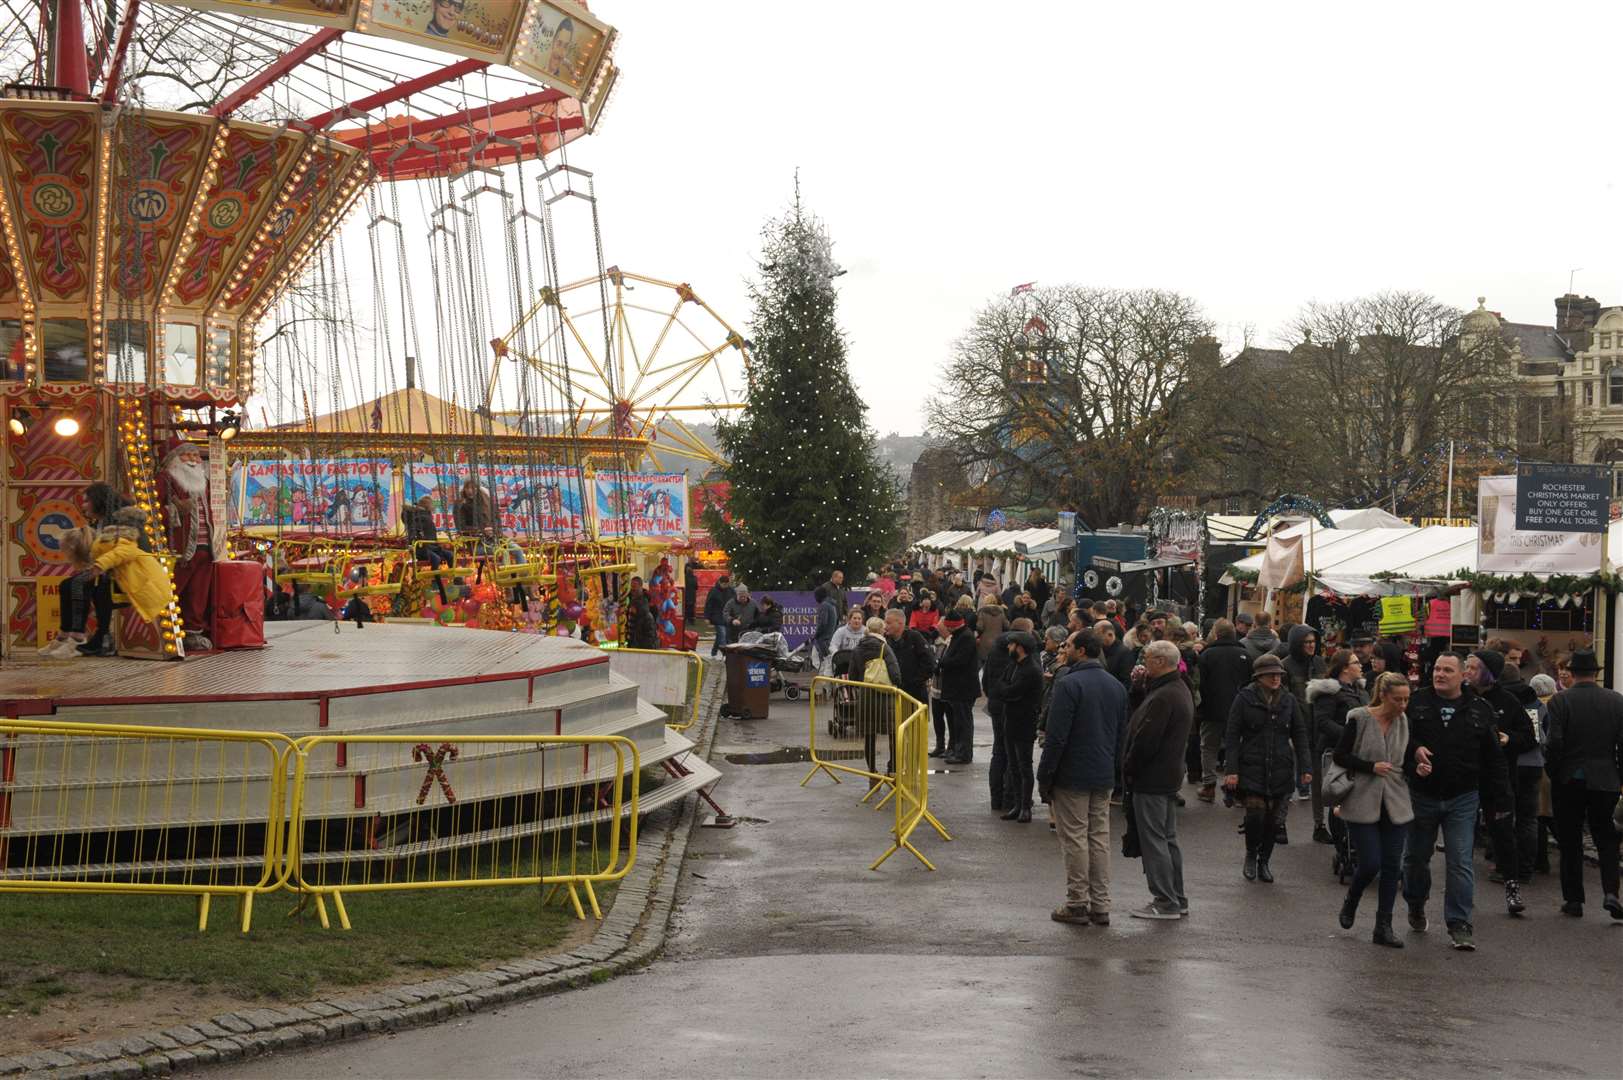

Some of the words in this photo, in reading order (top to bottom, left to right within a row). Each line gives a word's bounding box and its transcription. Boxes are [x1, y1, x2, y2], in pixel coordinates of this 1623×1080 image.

[298, 463, 322, 475] TOY
[327, 462, 388, 475] FACTORY
[1542, 483, 1586, 491] ROCHESTER
[1527, 491, 1569, 499] CHRISTMAS
[1570, 492, 1600, 500] MARKET
[1537, 499, 1557, 507] ONLY
[1529, 507, 1543, 515] BUY
[1545, 508, 1564, 516] ONE
[1580, 509, 1598, 517] ONE
[540, 514, 581, 529] TIME
[656, 518, 681, 531] TIME
[1421, 517, 1471, 528] KITCHEN
[1525, 516, 1543, 524] FREE
[1545, 516, 1558, 524] ON
[783, 626, 817, 635] MARK
